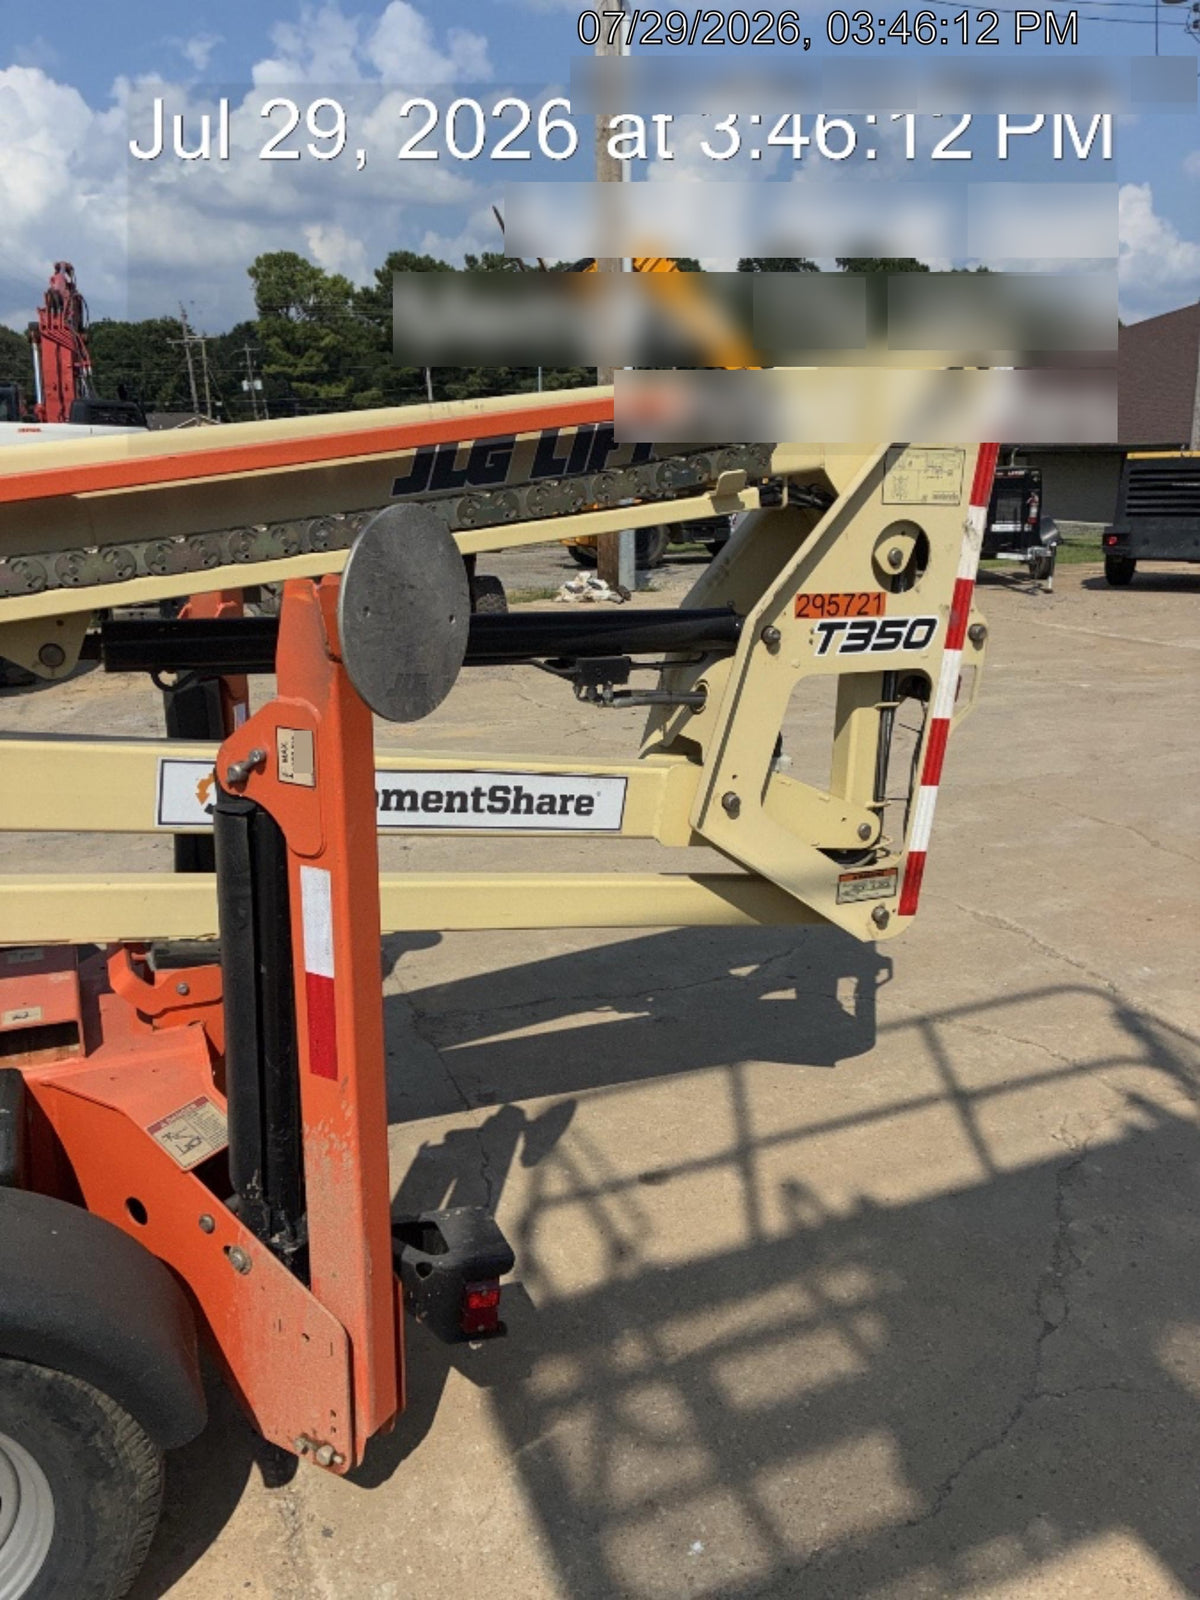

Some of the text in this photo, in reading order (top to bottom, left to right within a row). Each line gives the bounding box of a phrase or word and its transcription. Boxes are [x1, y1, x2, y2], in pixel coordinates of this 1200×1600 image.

[390, 434, 517, 497] JLG
[796, 592, 882, 618] 295721
[816, 617, 938, 655] T350
[376, 785, 595, 817] mentShare
